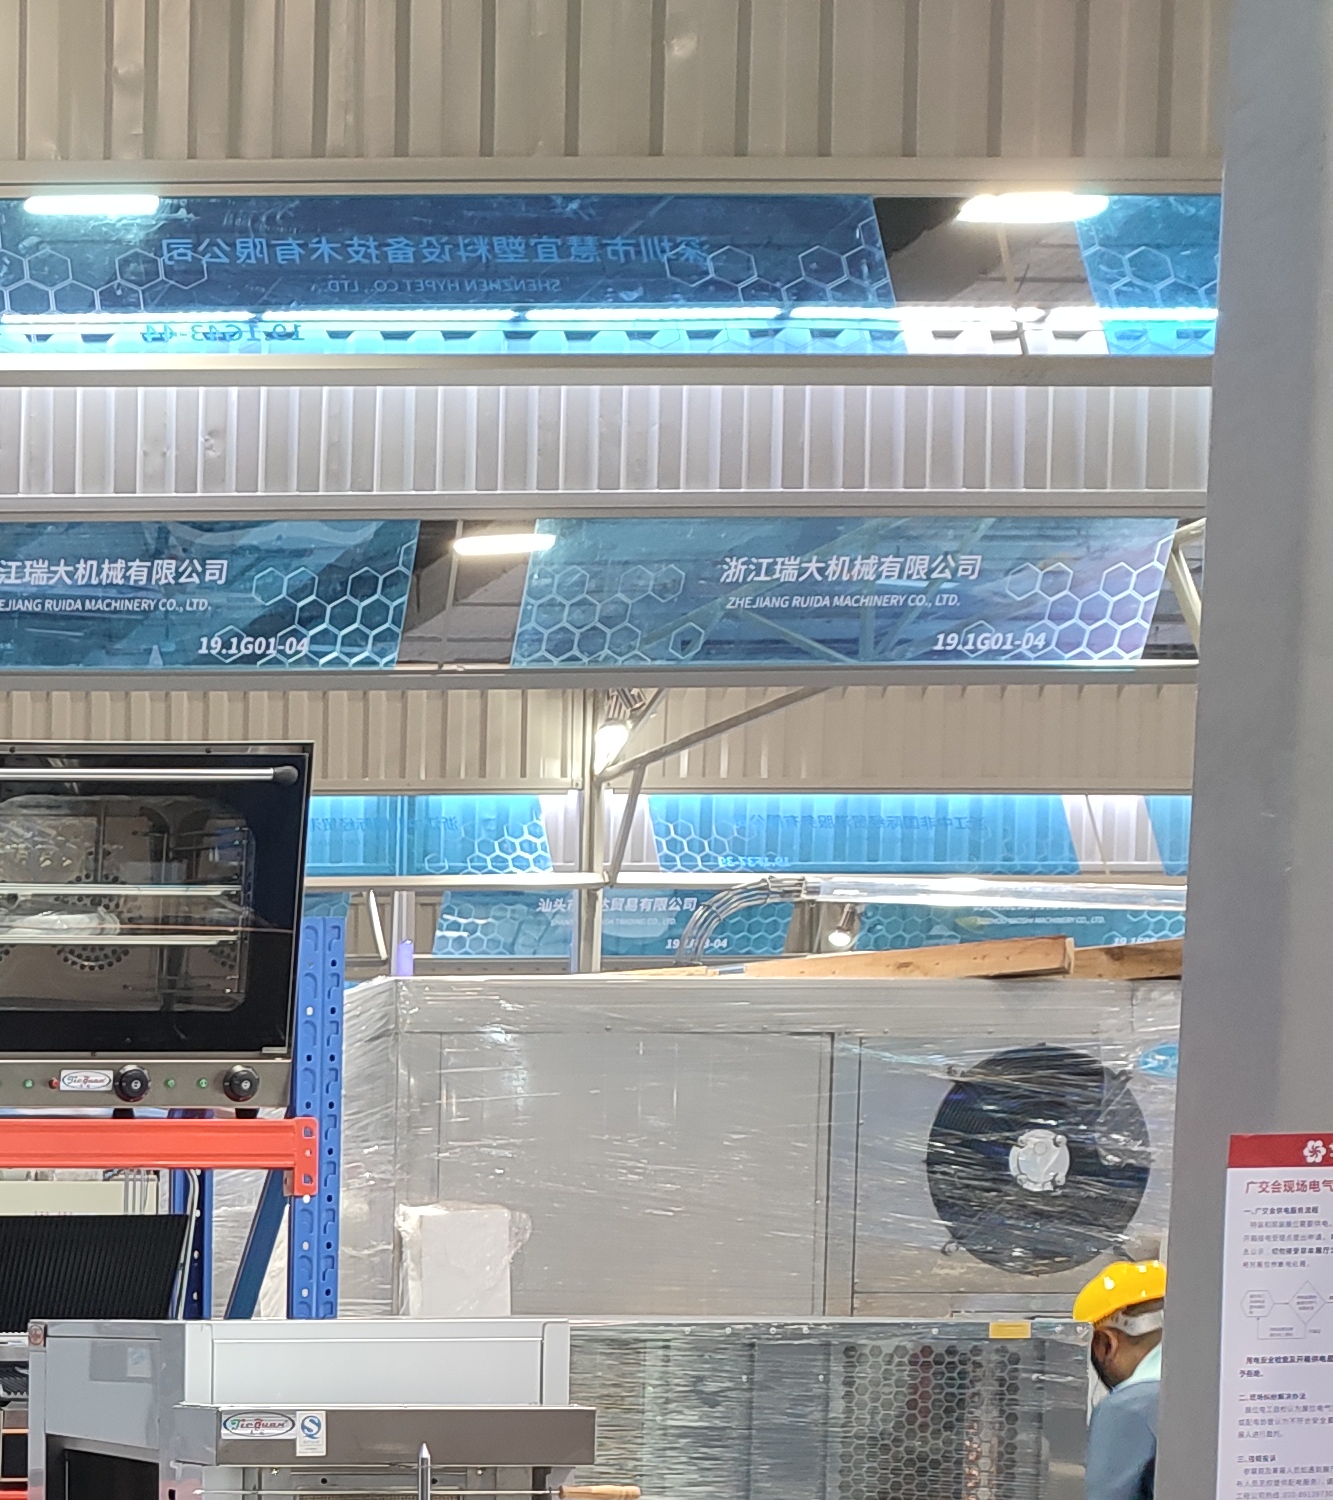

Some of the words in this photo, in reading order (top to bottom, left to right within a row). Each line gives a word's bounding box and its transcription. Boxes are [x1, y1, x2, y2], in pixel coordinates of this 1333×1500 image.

[719, 554, 983, 583] 浙江瑞大机械有限公司
[44, 599, 83, 611] RUIDA
[84, 599, 157, 612] MACHINERY
[158, 599, 184, 613] CO.,
[185, 599, 212, 612] LTD.
[725, 595, 790, 609] ZHEJIANG
[791, 595, 831, 608] RUIDA
[833, 595, 906, 608] MACHINERY
[907, 594, 933, 609] CO.,
[934, 594, 960, 607] LTD.
[197, 636, 309, 655] 19.1G01-04
[933, 632, 1047, 651] 19.1G01-04
